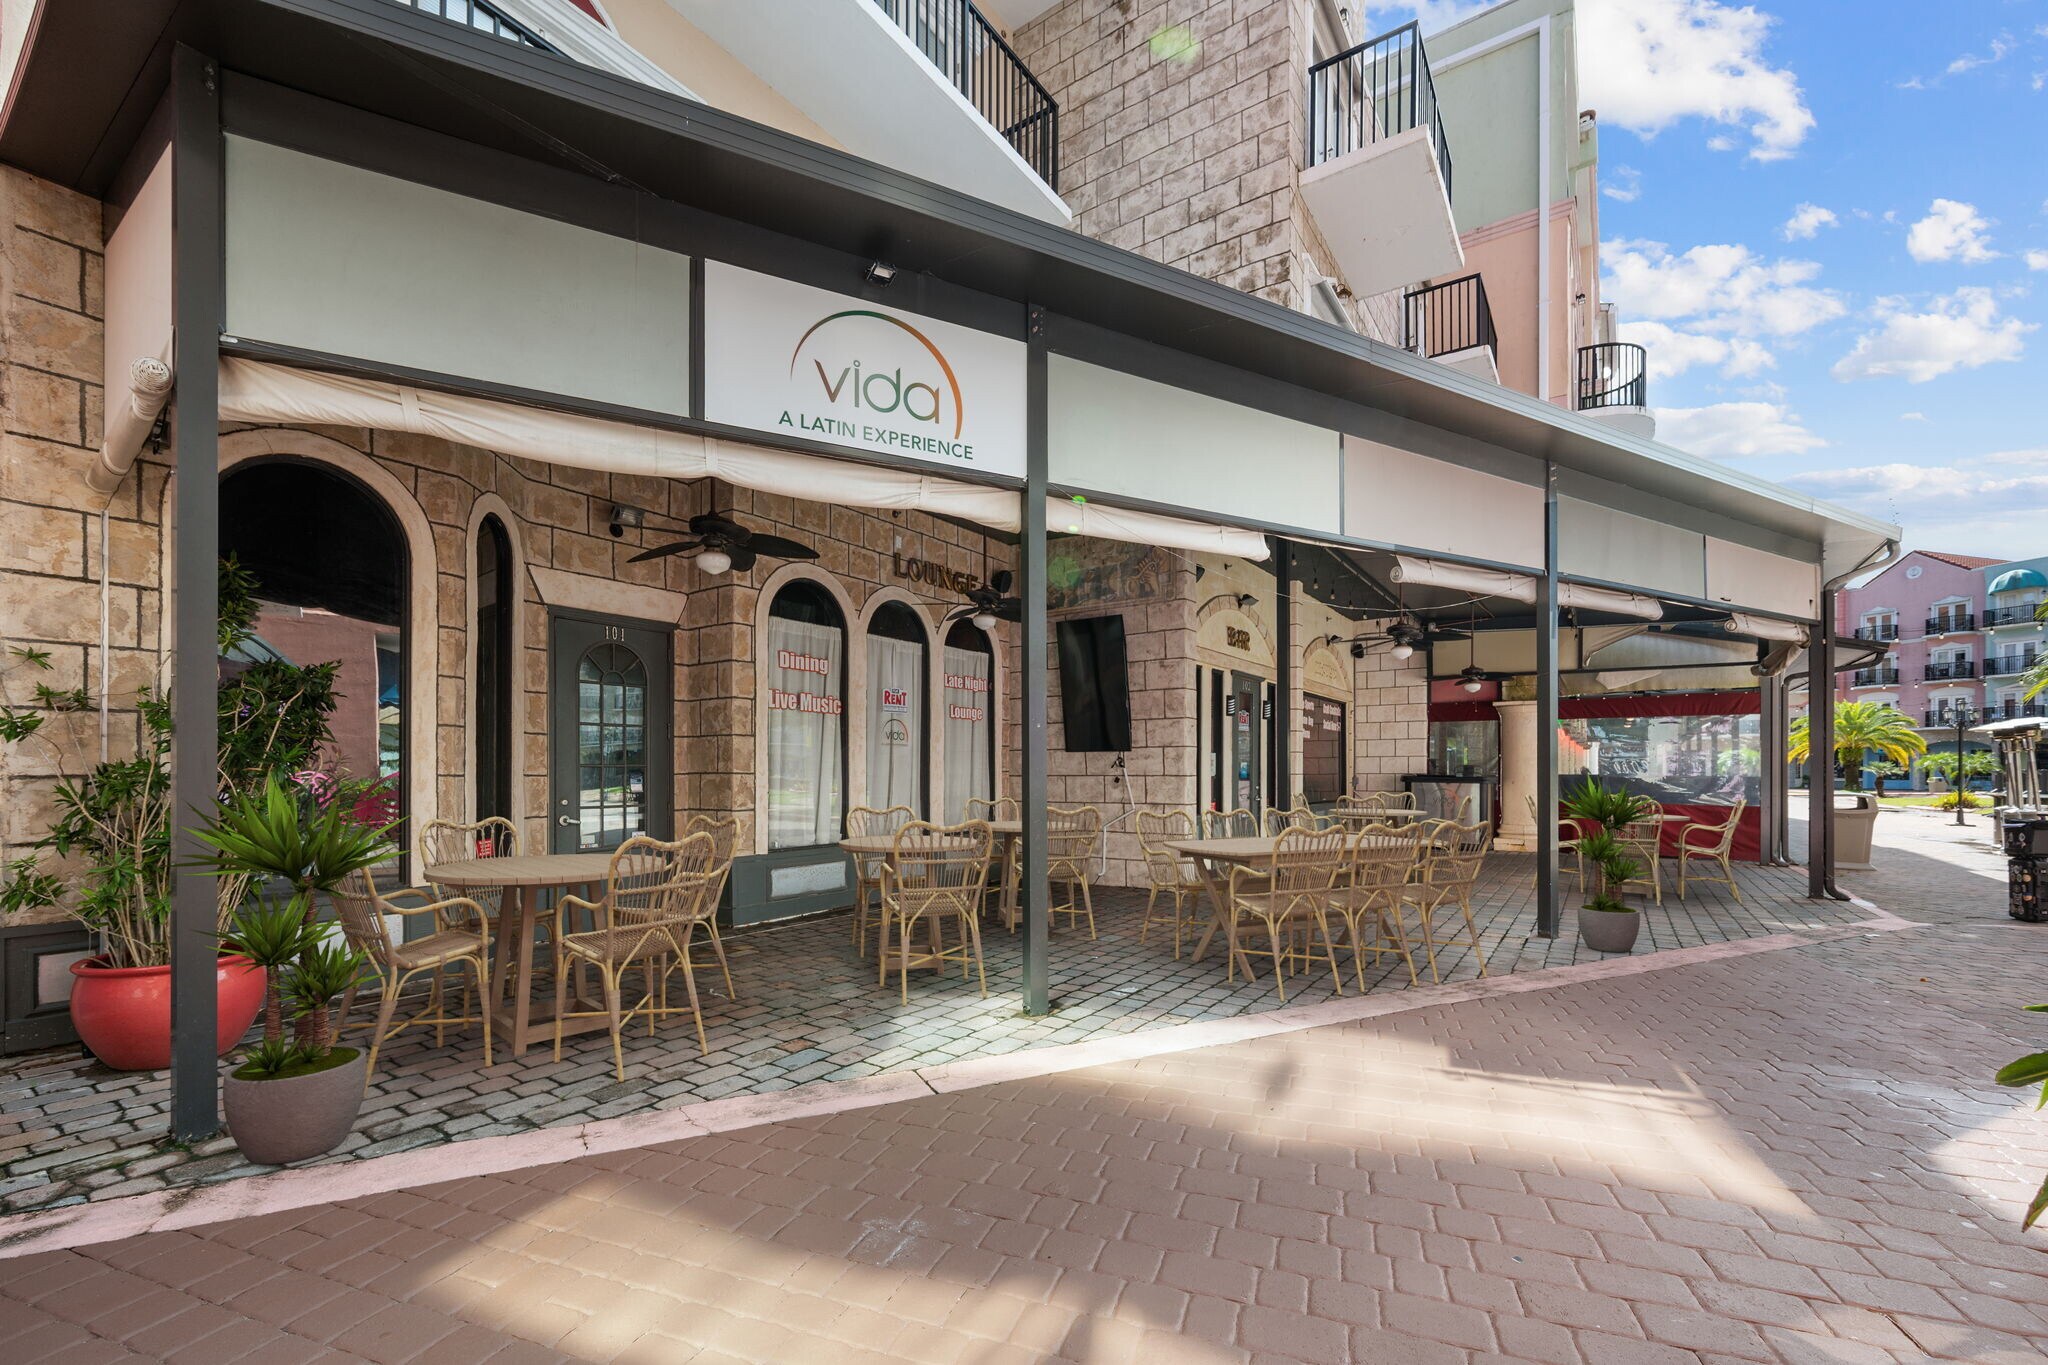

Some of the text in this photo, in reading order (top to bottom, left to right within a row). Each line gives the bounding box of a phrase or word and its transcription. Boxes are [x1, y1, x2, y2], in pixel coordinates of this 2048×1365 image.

[814, 359, 939, 424] vida
[778, 410, 973, 460] A LATIN EXPERIENCE
[605, 626, 625, 642] 101
[778, 650, 829, 676] Dining
[944, 672, 988, 693] Late Night
[768, 688, 843, 716] Live Music
[884, 690, 907, 706] RENT
[949, 703, 983, 721] Lounge
